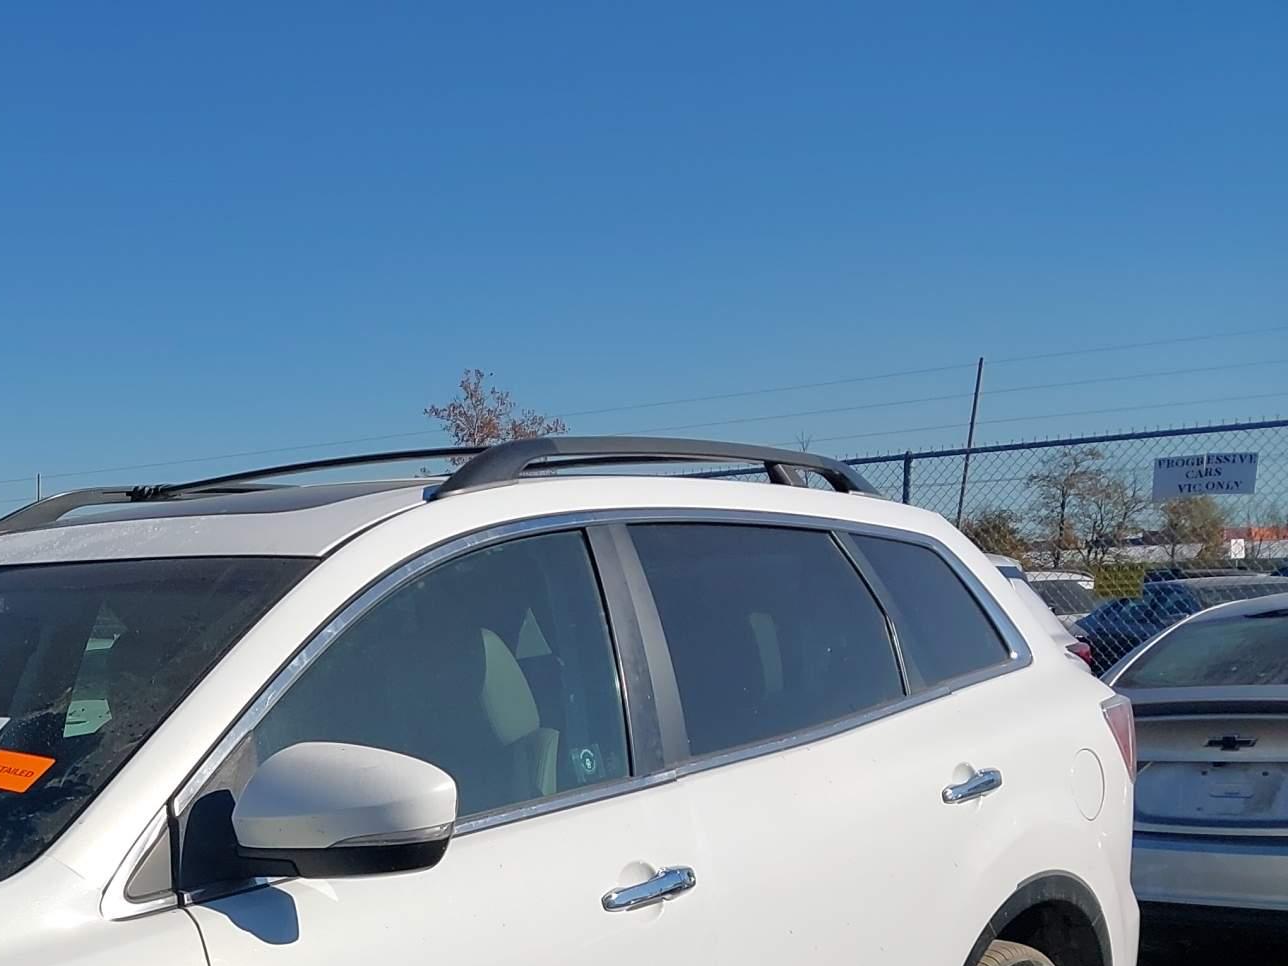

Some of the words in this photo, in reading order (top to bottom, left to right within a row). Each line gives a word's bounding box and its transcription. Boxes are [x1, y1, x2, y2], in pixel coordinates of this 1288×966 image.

[1157, 453, 1258, 469] PROGRESSIVE
[1185, 467, 1222, 479] CARS
[1205, 480, 1242, 491] ONLY
